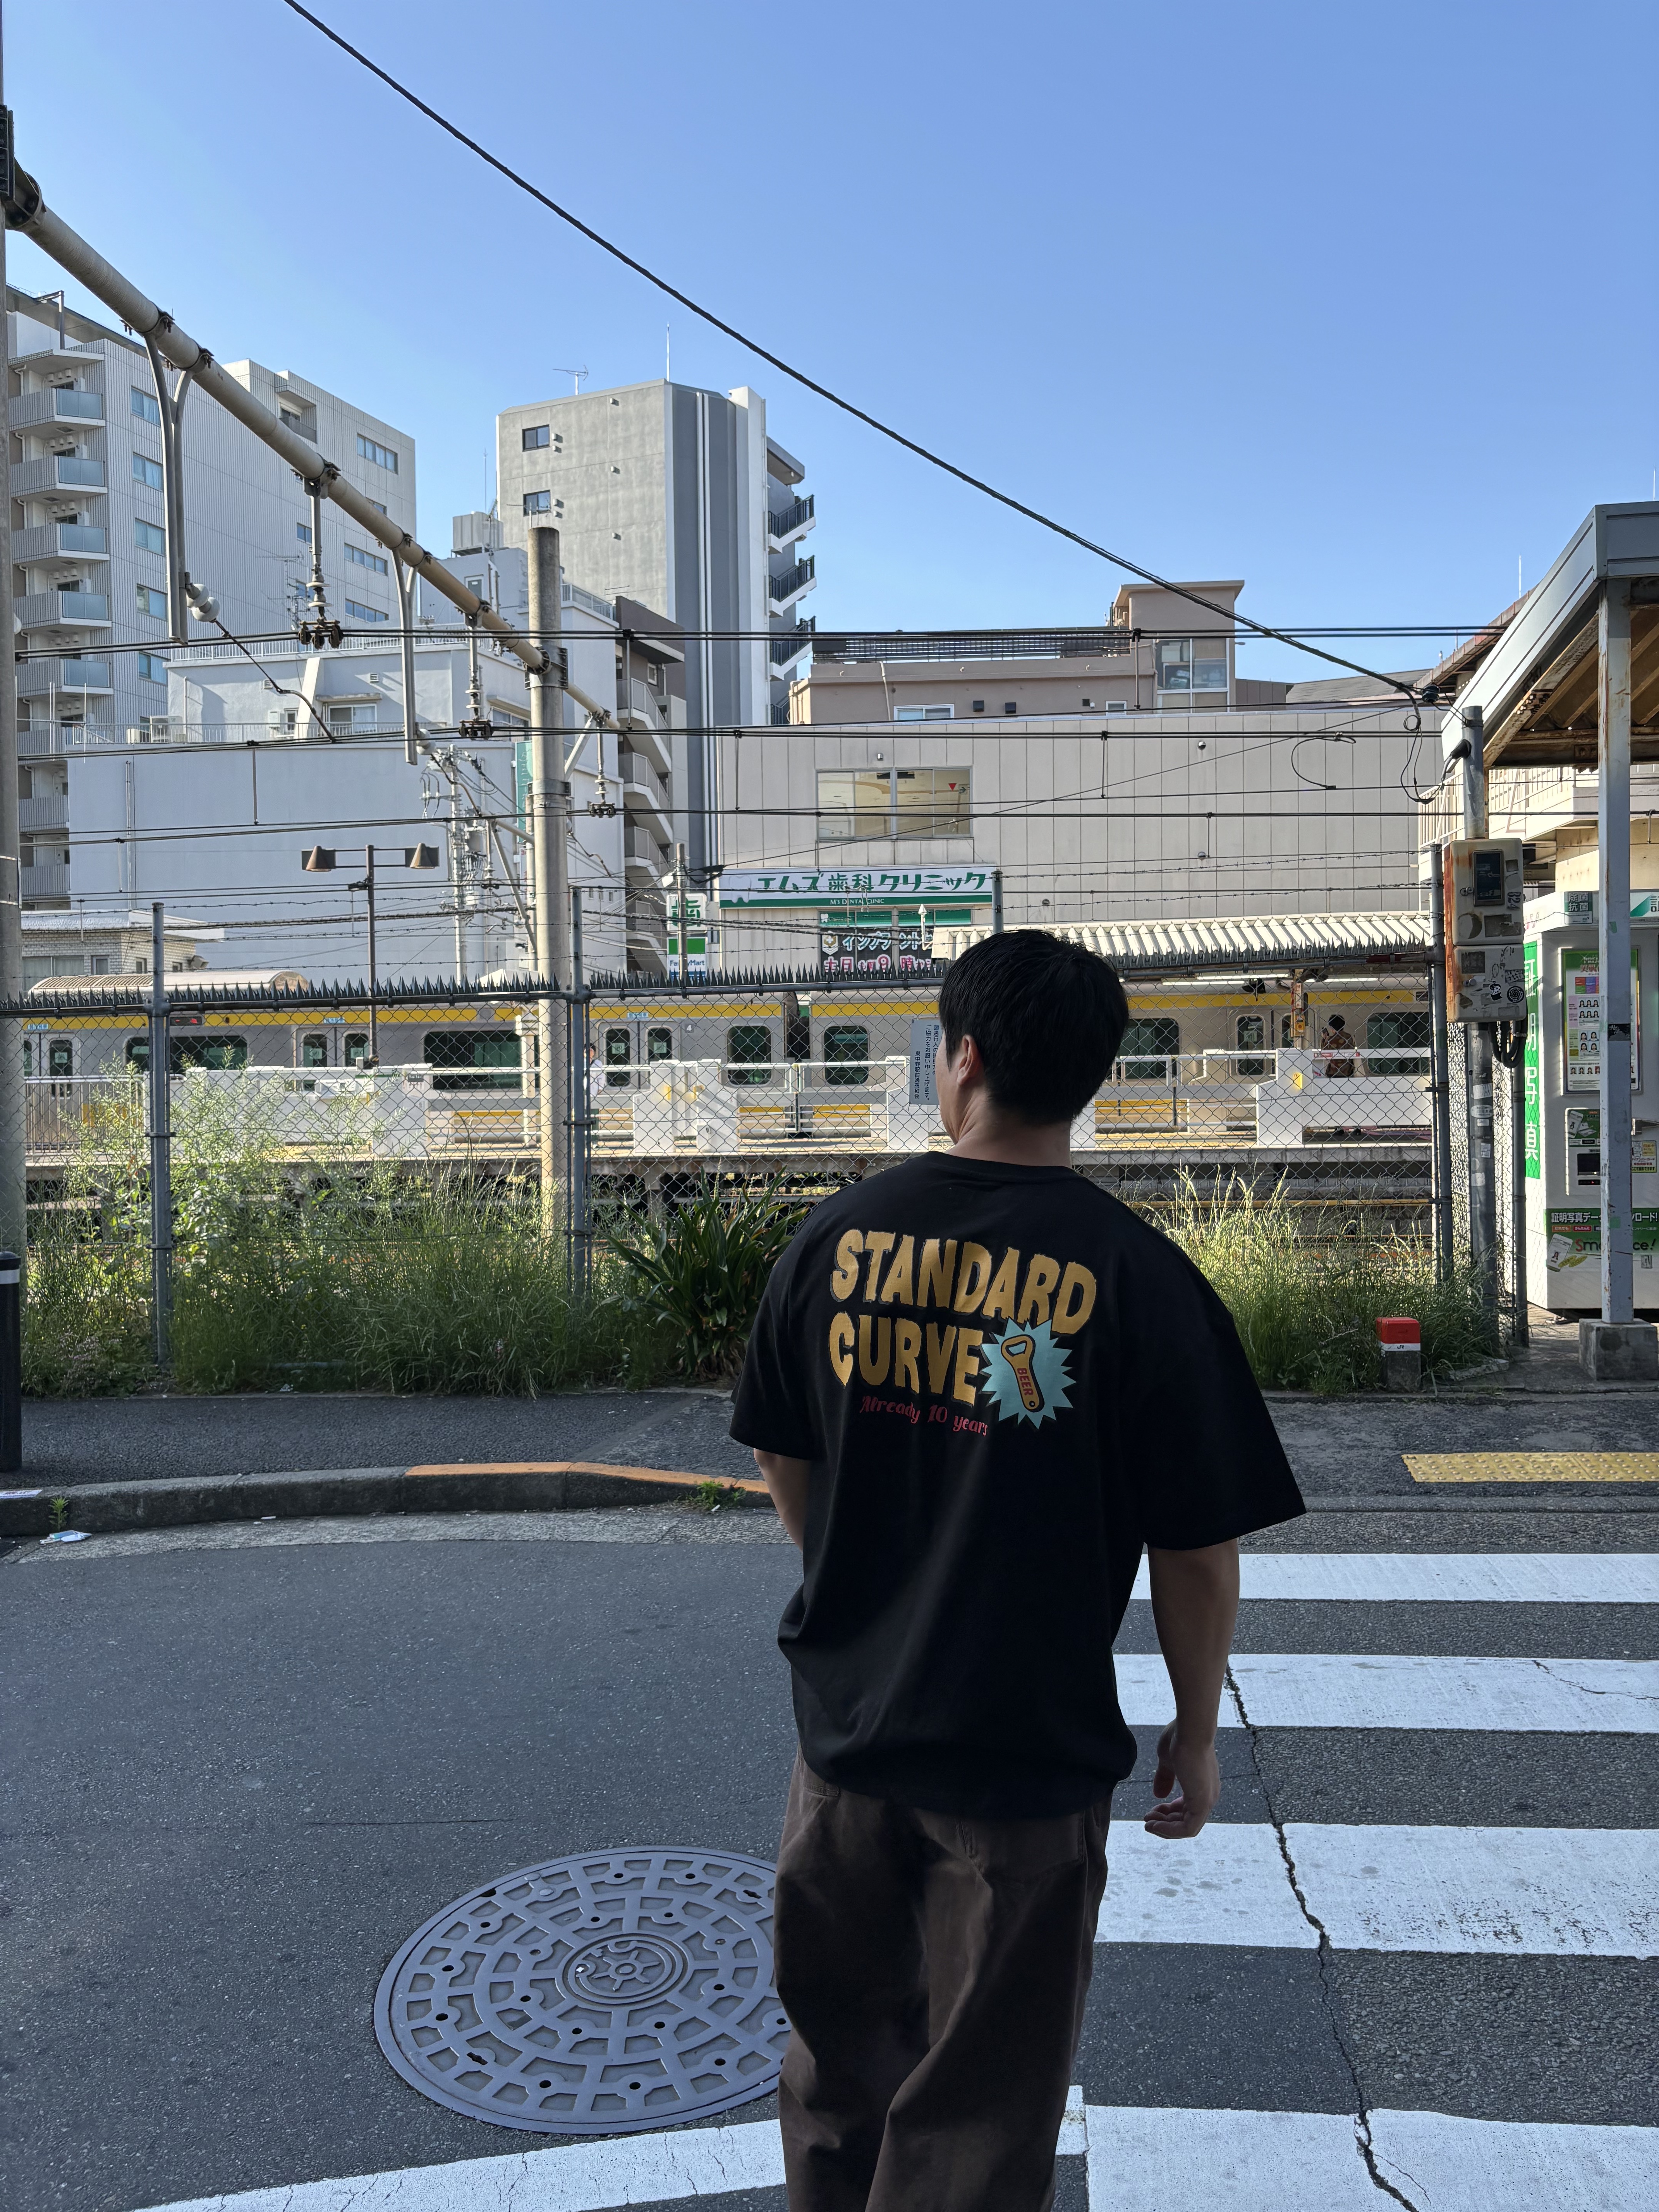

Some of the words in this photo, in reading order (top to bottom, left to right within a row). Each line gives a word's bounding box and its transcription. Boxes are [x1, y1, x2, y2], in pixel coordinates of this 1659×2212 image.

[758, 872, 986, 893] エムズ歯科クリニック
[1568, 902, 1589, 912] 抗菌
[830, 1228, 1097, 1334] STANDARD
[828, 1311, 984, 1407] CURVE
[1017, 1368, 1034, 1396] BEER
[860, 1395, 921, 1424] Already
[928, 1404, 948, 1423] 10
[953, 1415, 988, 1436] years
